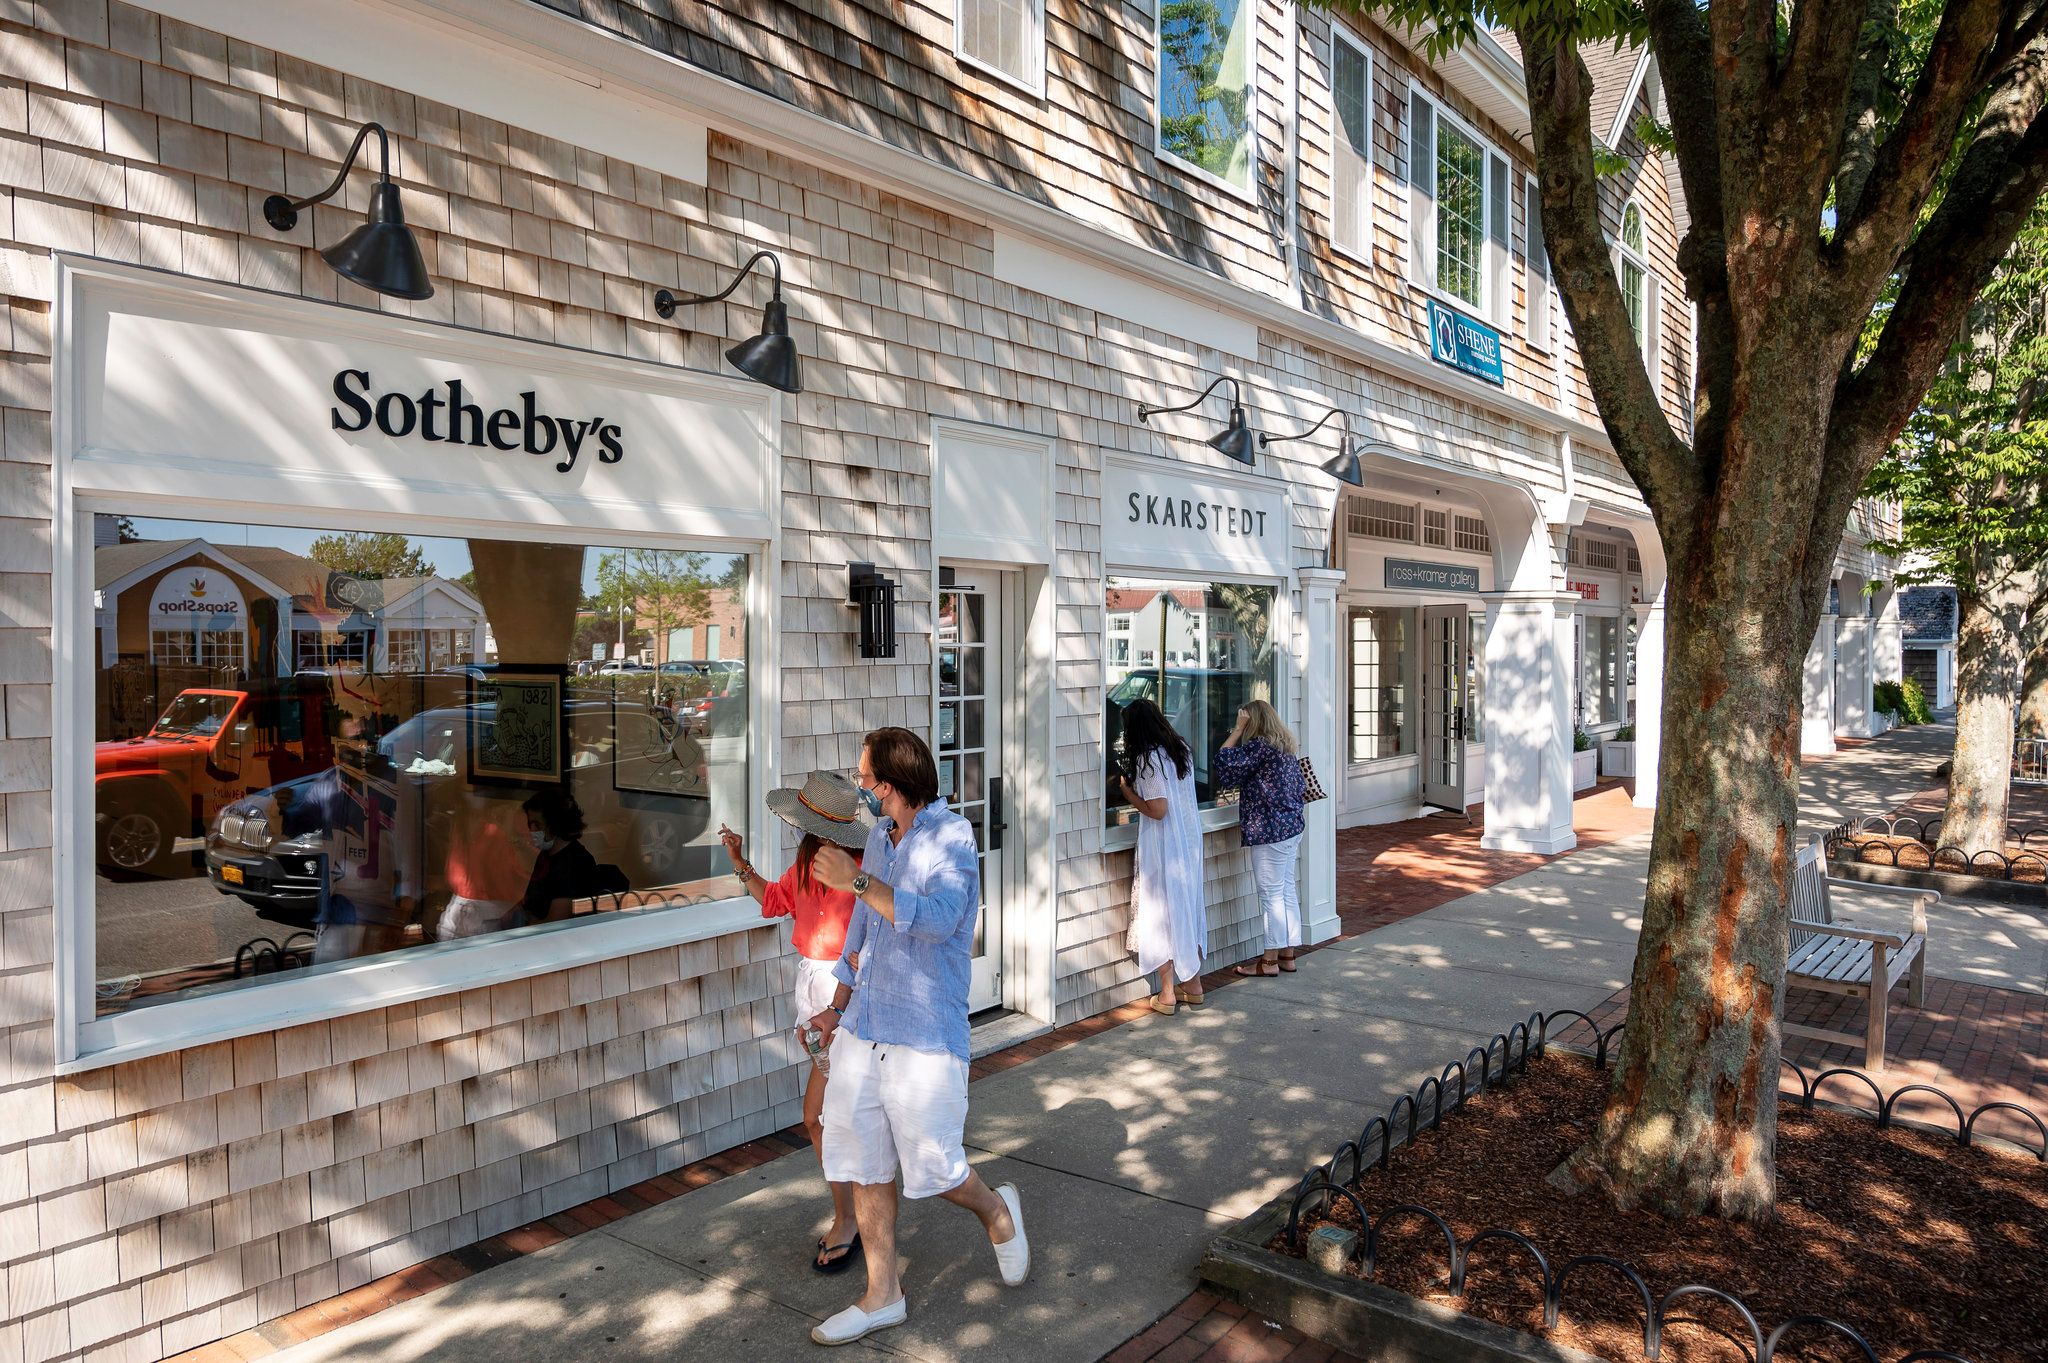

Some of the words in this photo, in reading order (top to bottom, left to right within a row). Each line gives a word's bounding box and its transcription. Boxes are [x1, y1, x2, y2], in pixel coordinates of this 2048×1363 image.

[1457, 323, 1496, 358] SHENE
[331, 368, 624, 473] Sotheby's
[1128, 492, 1267, 537] SKARSTEDT
[1450, 570, 1476, 589] gallery
[522, 688, 548, 706] 1982
[348, 847, 367, 859] FEET
